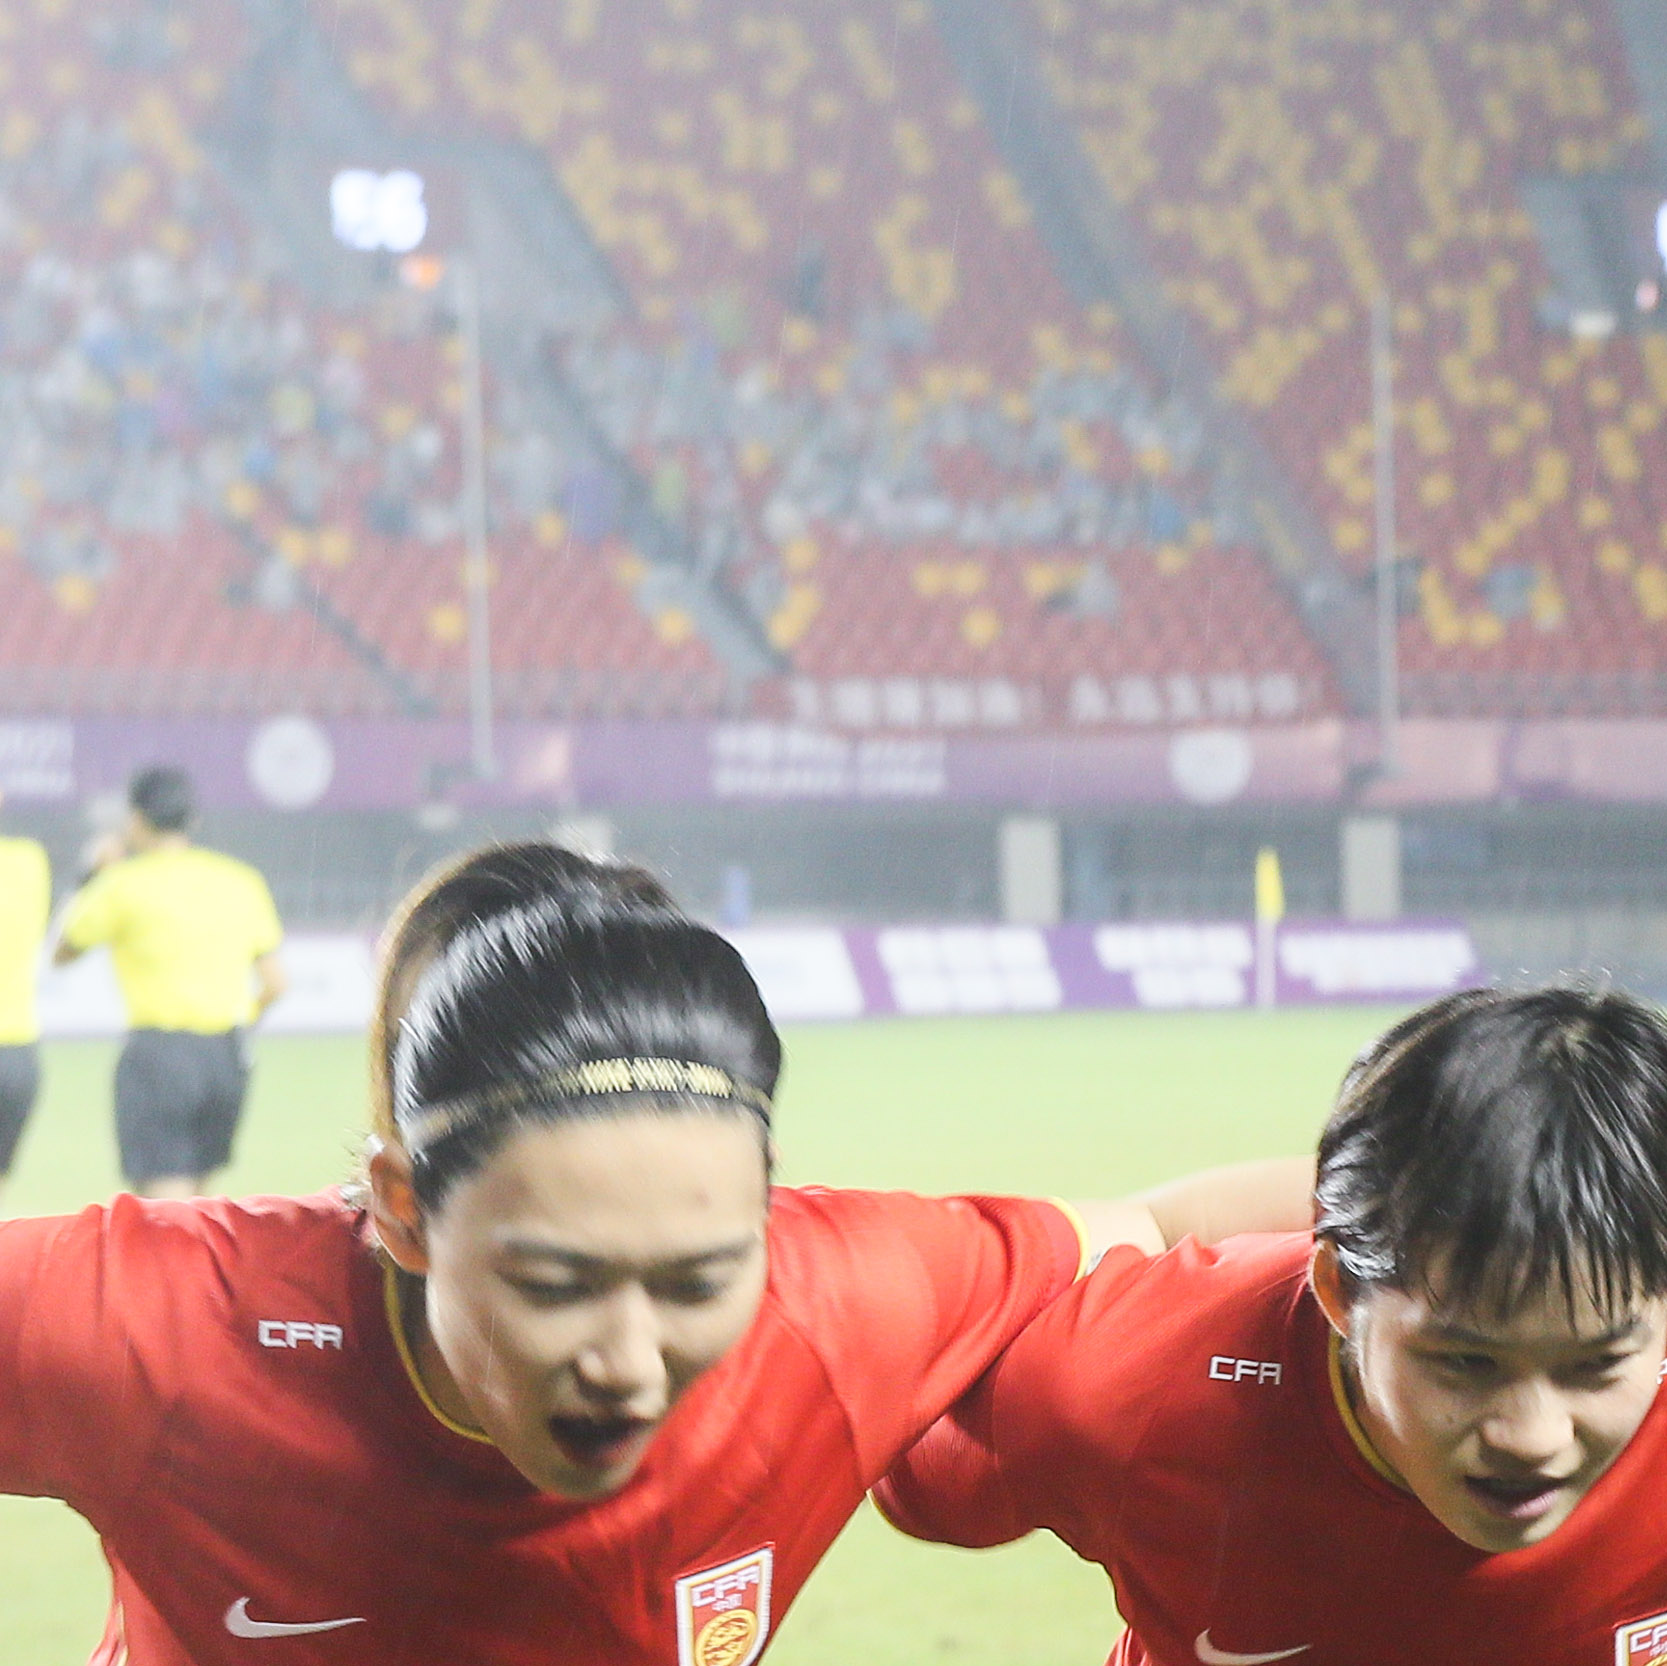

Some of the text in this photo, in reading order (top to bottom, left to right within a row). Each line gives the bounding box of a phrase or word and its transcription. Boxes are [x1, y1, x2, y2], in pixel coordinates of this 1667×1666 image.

[258, 1320, 343, 1349] CFA
[1208, 1355, 1282, 1385] CFA
[691, 1566, 760, 1607] CFA
